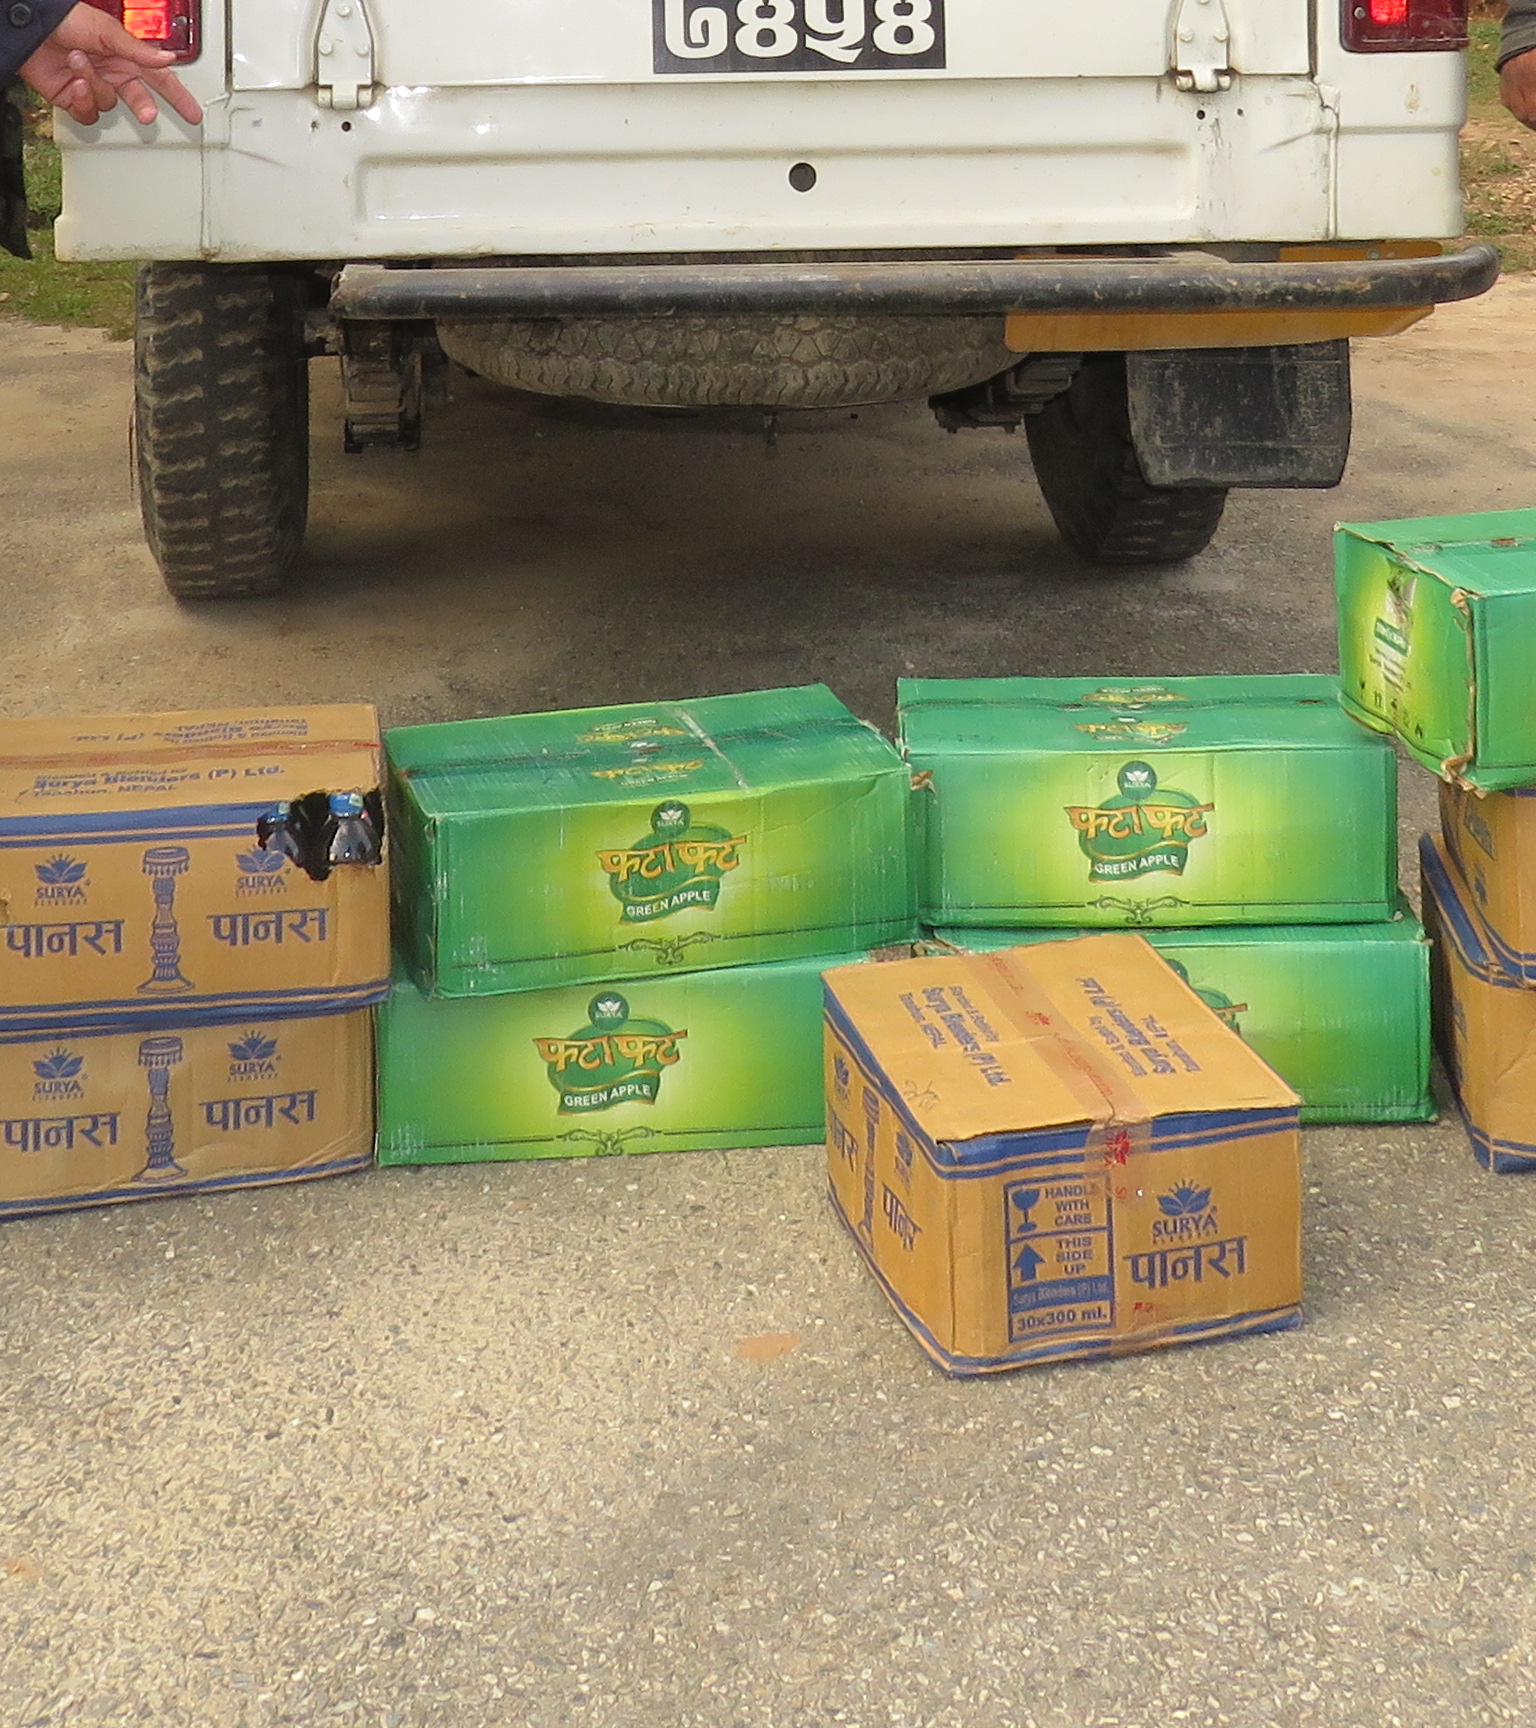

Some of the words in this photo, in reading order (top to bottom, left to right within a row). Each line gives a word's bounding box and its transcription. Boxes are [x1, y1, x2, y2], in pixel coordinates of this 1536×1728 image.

[1095, 860, 1137, 875] GREEN
[1139, 854, 1180, 868] APPLE
[237, 874, 285, 890] SURYA
[36, 885, 85, 900] SURYA
[626, 899, 670, 917] GREEN
[670, 890, 710, 906] APPLE
[207, 908, 329, 946] पानस
[0, 920, 125, 958] पानस
[229, 1062, 275, 1075] SURYA
[34, 1080, 82, 1095] SURYA
[564, 1091, 609, 1107] GREEN
[609, 1084, 652, 1100] APPLE
[199, 1089, 319, 1132] पानस
[1056, 1201, 1089, 1213] WITH
[1055, 1214, 1092, 1227] CARE
[1152, 1215, 1217, 1237] SURYA
[1057, 1236, 1092, 1249] THIS
[1057, 1249, 1092, 1263] SIDE
[1123, 1235, 1247, 1290] पानस
[1064, 1264, 1086, 1275] UP
[1017, 1310, 1076, 1331] 30x300
[1081, 1305, 1108, 1321] ml.
